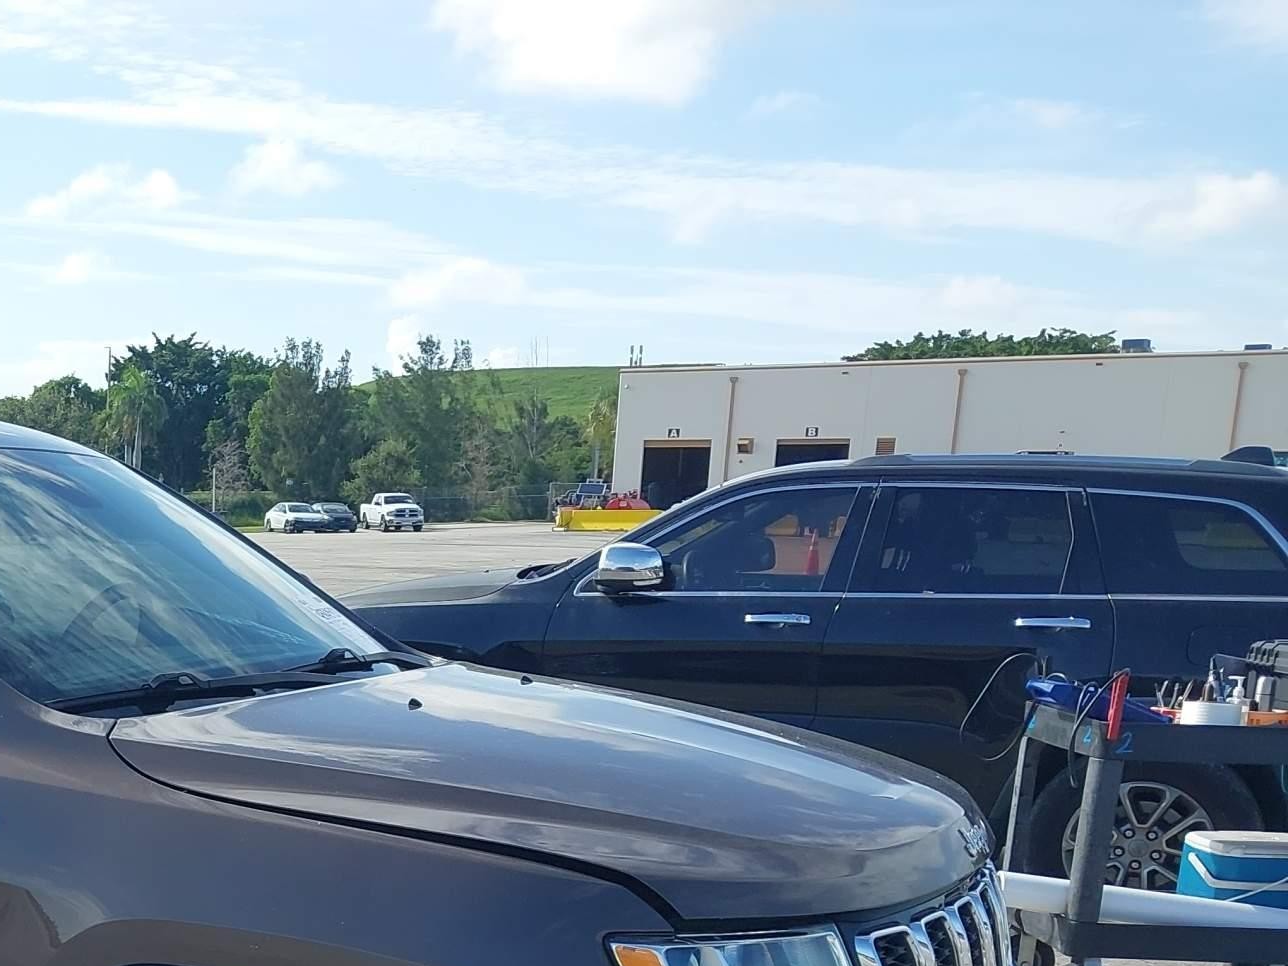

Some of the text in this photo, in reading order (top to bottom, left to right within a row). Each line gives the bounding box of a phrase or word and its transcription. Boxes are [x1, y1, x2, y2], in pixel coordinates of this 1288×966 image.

[669, 429, 679, 438] A
[807, 427, 817, 437] B
[1116, 732, 1133, 754] 2
